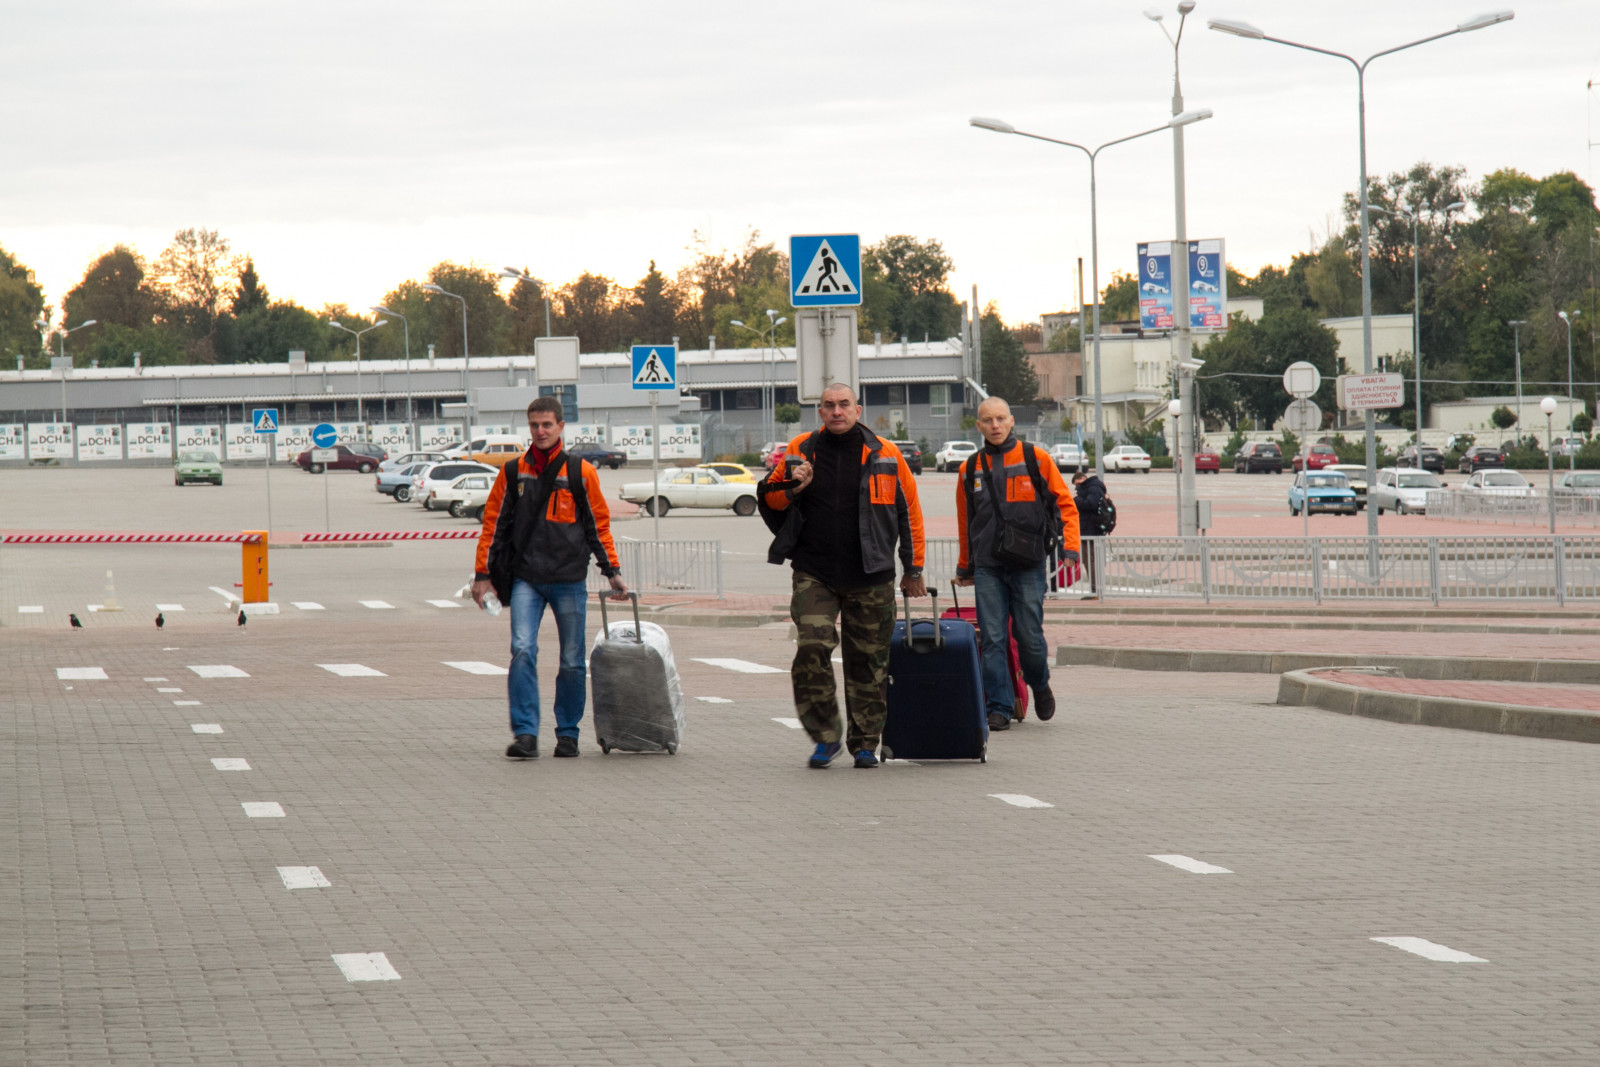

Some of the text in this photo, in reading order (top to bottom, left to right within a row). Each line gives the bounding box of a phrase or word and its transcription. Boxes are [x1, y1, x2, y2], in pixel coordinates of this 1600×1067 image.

[1149, 260, 1155, 273] 9
[1200, 259, 1206, 271] 9
[1361, 377, 1387, 385] УВАГА!
[1346, 386, 1372, 394] ОПЛАТА
[39, 435, 62, 444] DCH
[88, 437, 111, 446] DCH
[138, 435, 161, 444] DCH
[187, 437, 210, 446] DCH
[236, 435, 259, 444] DCH
[285, 437, 308, 446] DCH
[383, 436, 405, 445] DCH
[431, 436, 453, 446] DCH
[575, 436, 597, 444] DCH
[622, 437, 645, 446] DCH
[669, 436, 692, 445] DCH
